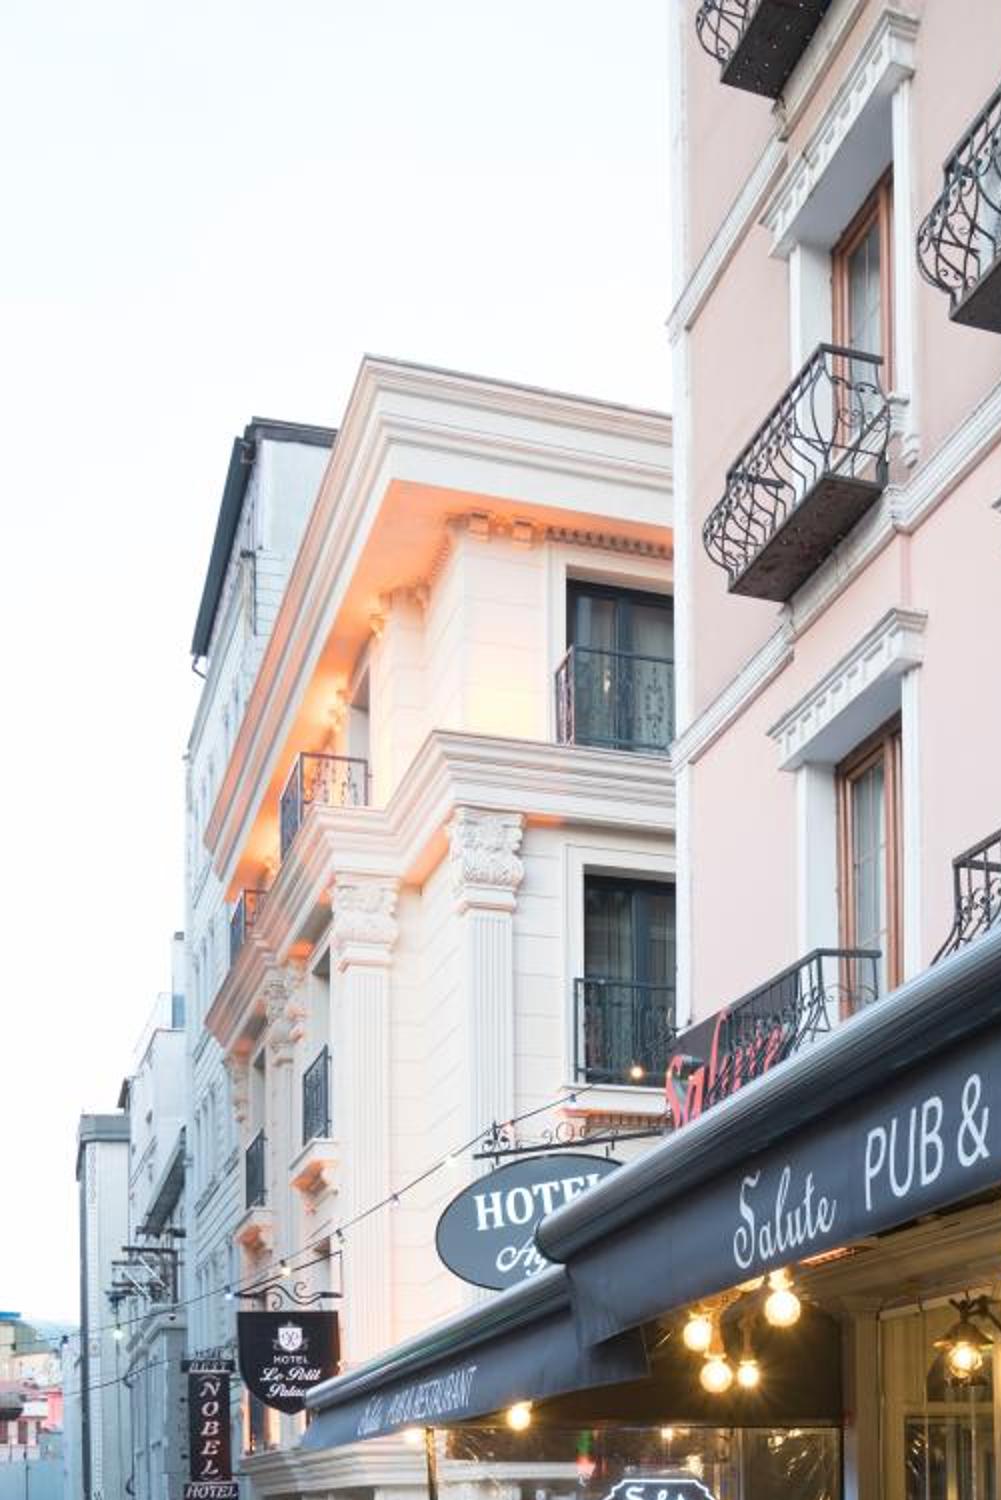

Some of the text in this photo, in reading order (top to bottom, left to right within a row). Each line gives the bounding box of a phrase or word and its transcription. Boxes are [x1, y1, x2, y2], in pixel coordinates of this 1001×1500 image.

[733, 1164, 838, 1269] Salute
[864, 1096, 945, 1212] PUB
[956, 1073, 991, 1168] &
[273, 1355, 309, 1364] HOTEL
[200, 1381, 221, 1475] NOBEL
[185, 1485, 238, 1499] HOTEL
